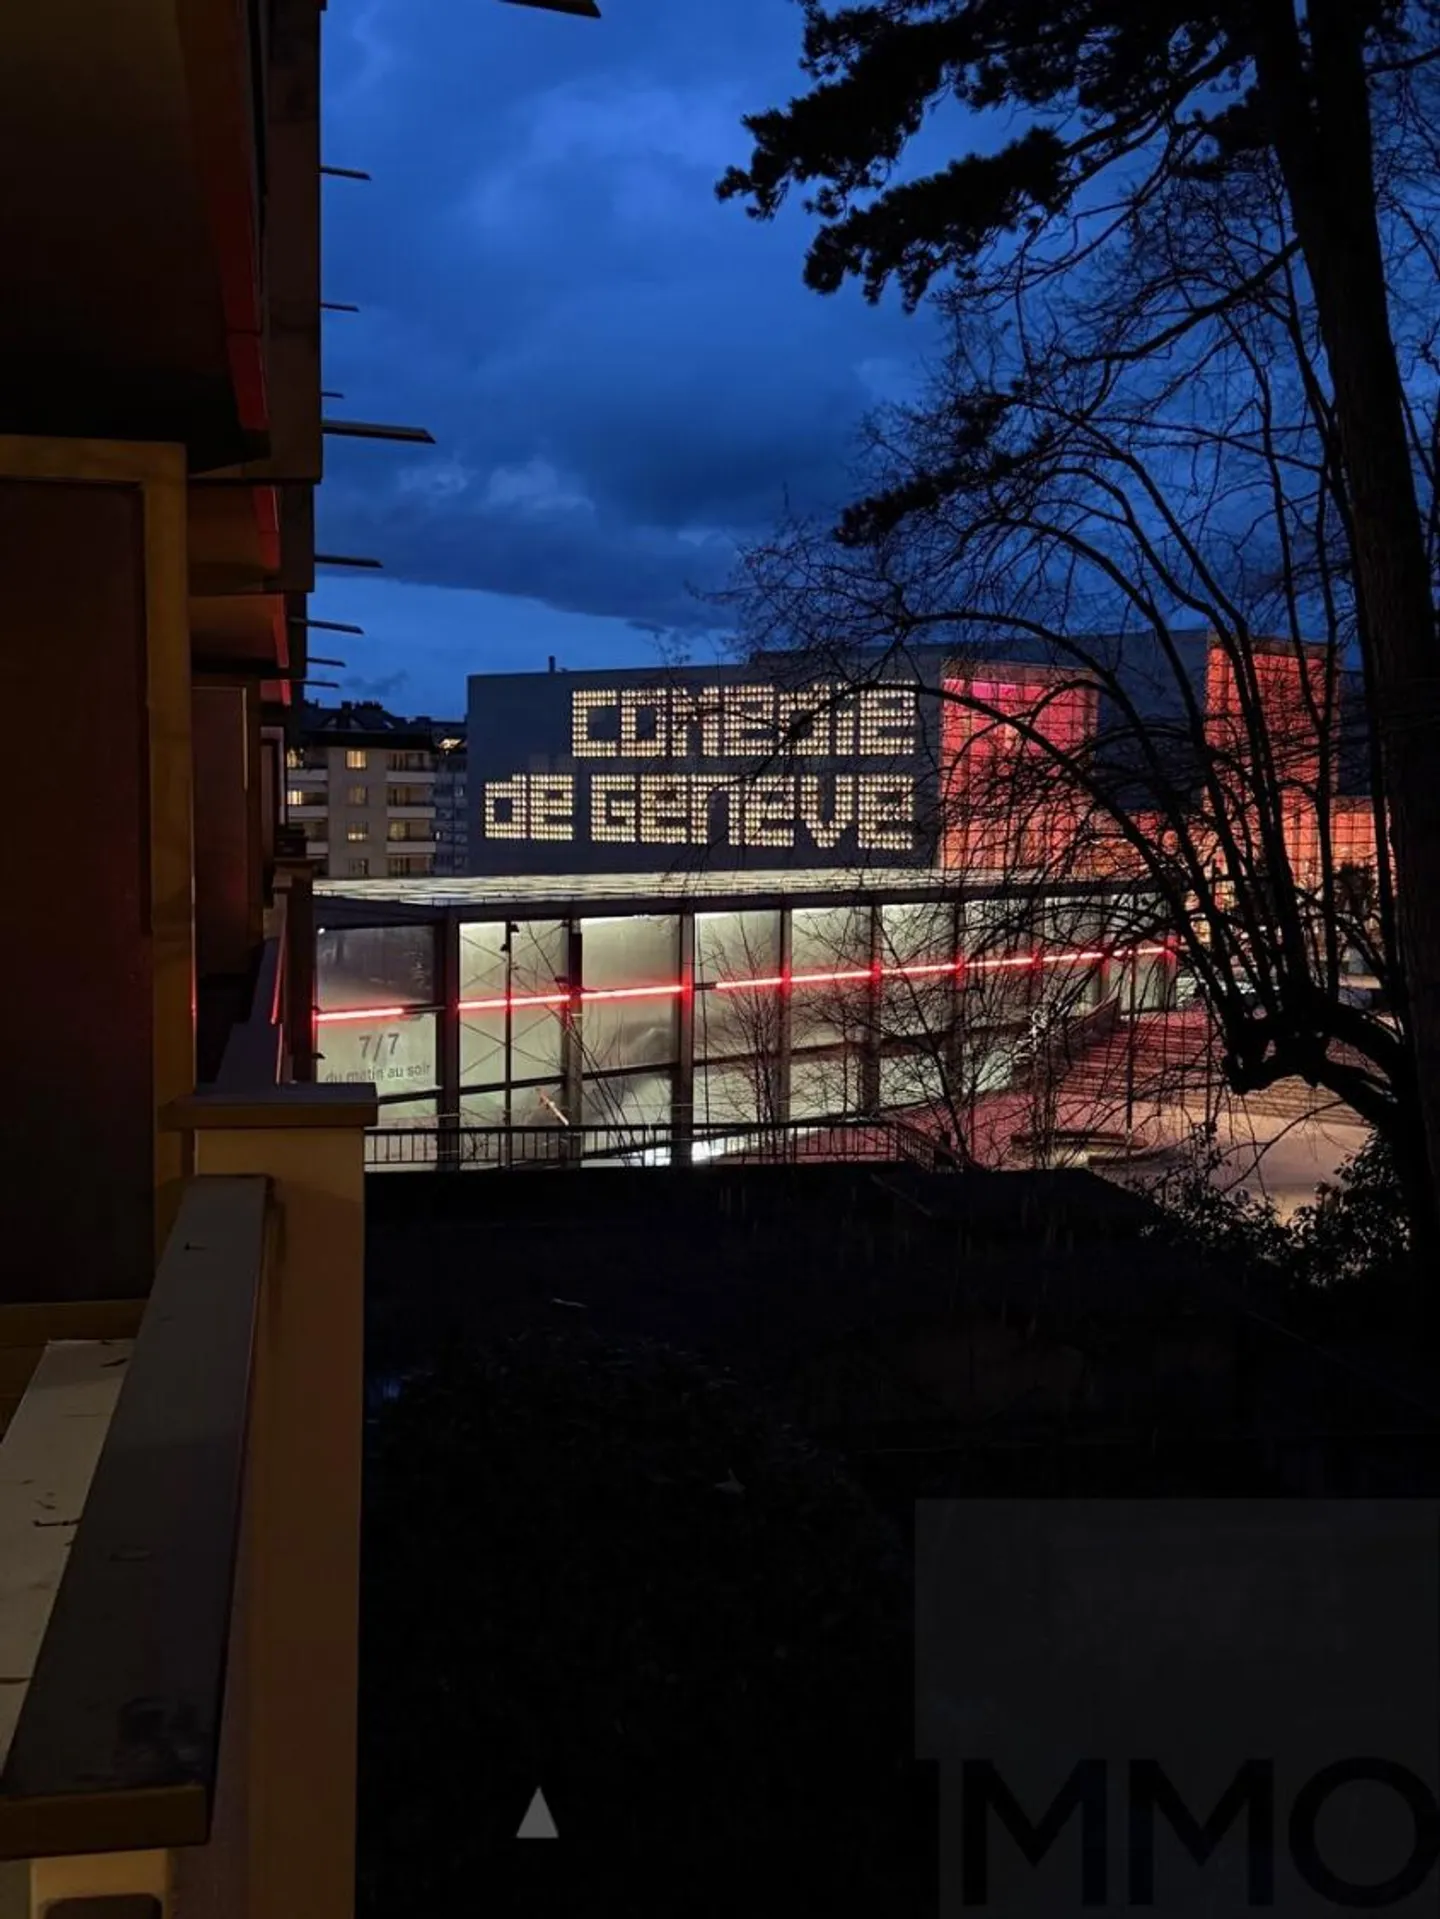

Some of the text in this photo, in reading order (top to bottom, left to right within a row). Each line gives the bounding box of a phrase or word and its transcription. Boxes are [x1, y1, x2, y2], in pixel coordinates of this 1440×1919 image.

[359, 1032, 400, 1062] 7/7
[326, 1061, 430, 1083] du matin au soir
